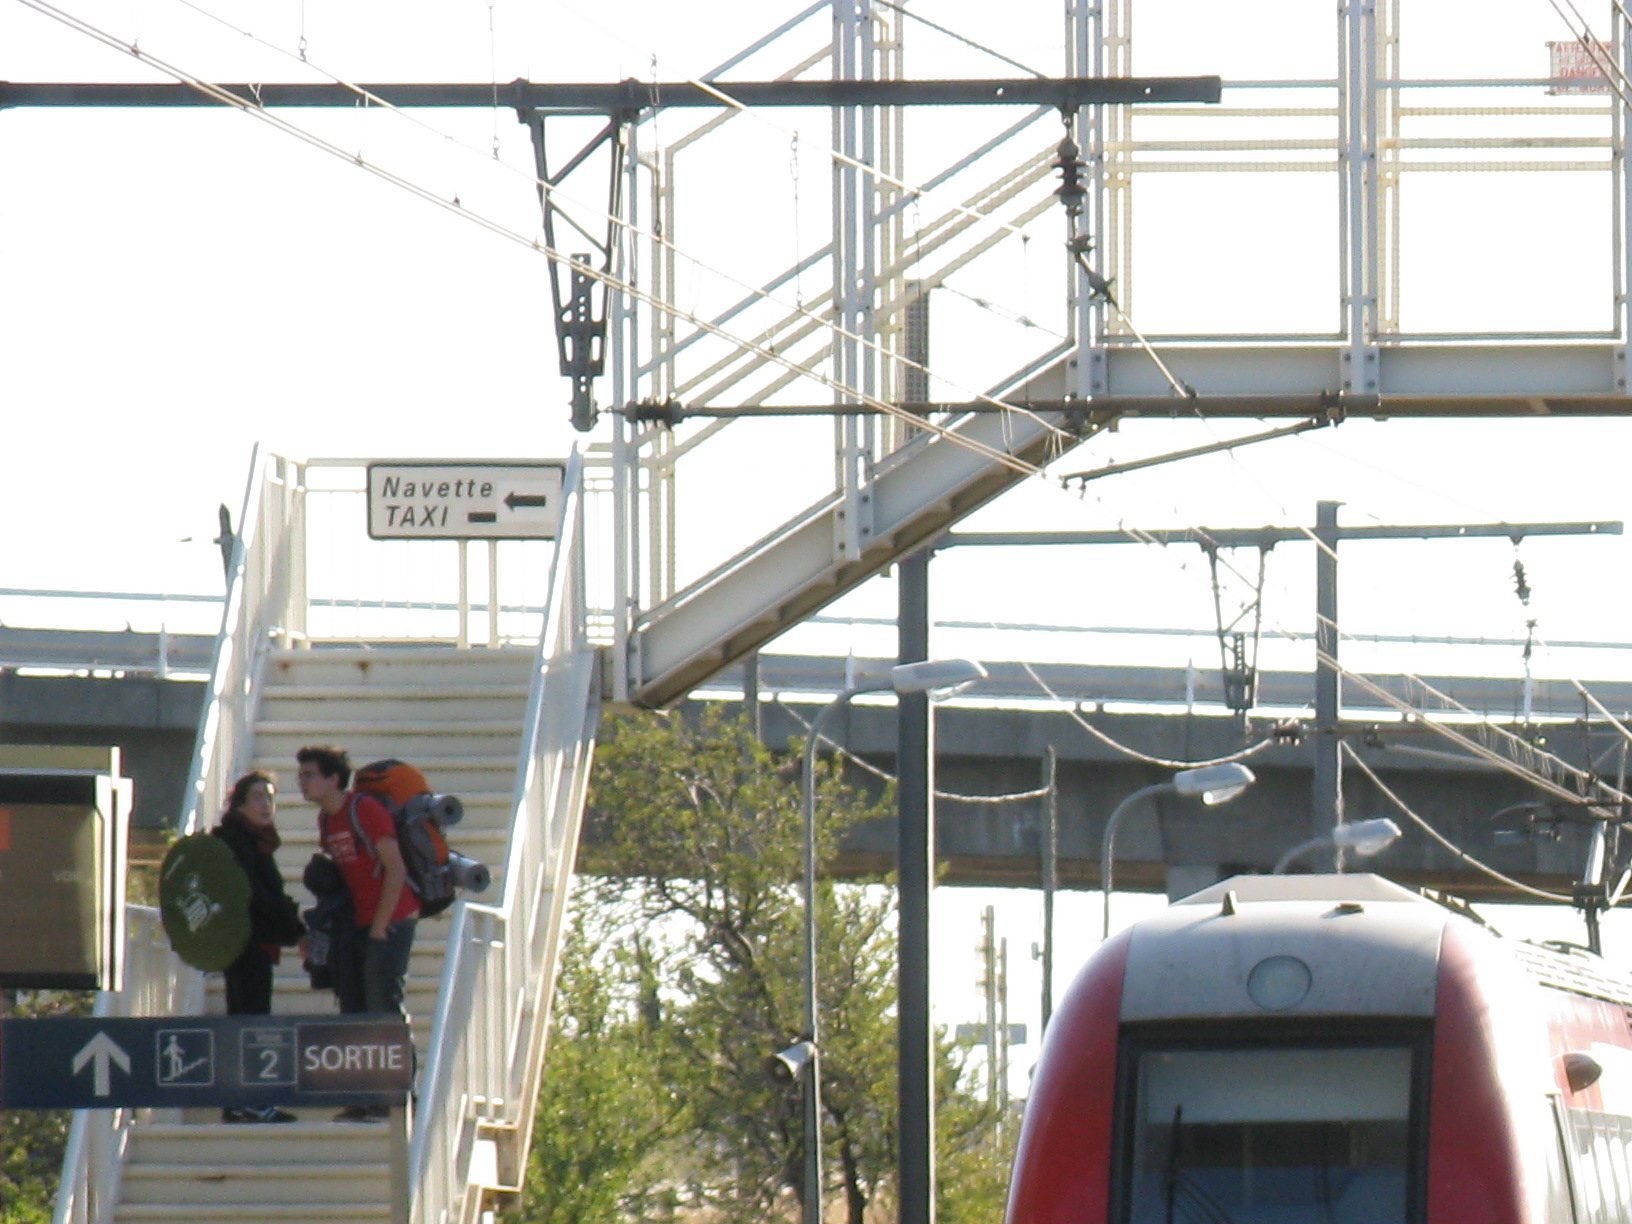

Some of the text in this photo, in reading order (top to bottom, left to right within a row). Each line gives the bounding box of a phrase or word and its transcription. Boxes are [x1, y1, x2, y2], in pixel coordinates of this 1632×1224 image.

[382, 476, 494, 498] Navette
[386, 505, 449, 527] TAXI
[259, 1043, 403, 1079] 2 SORTIE
